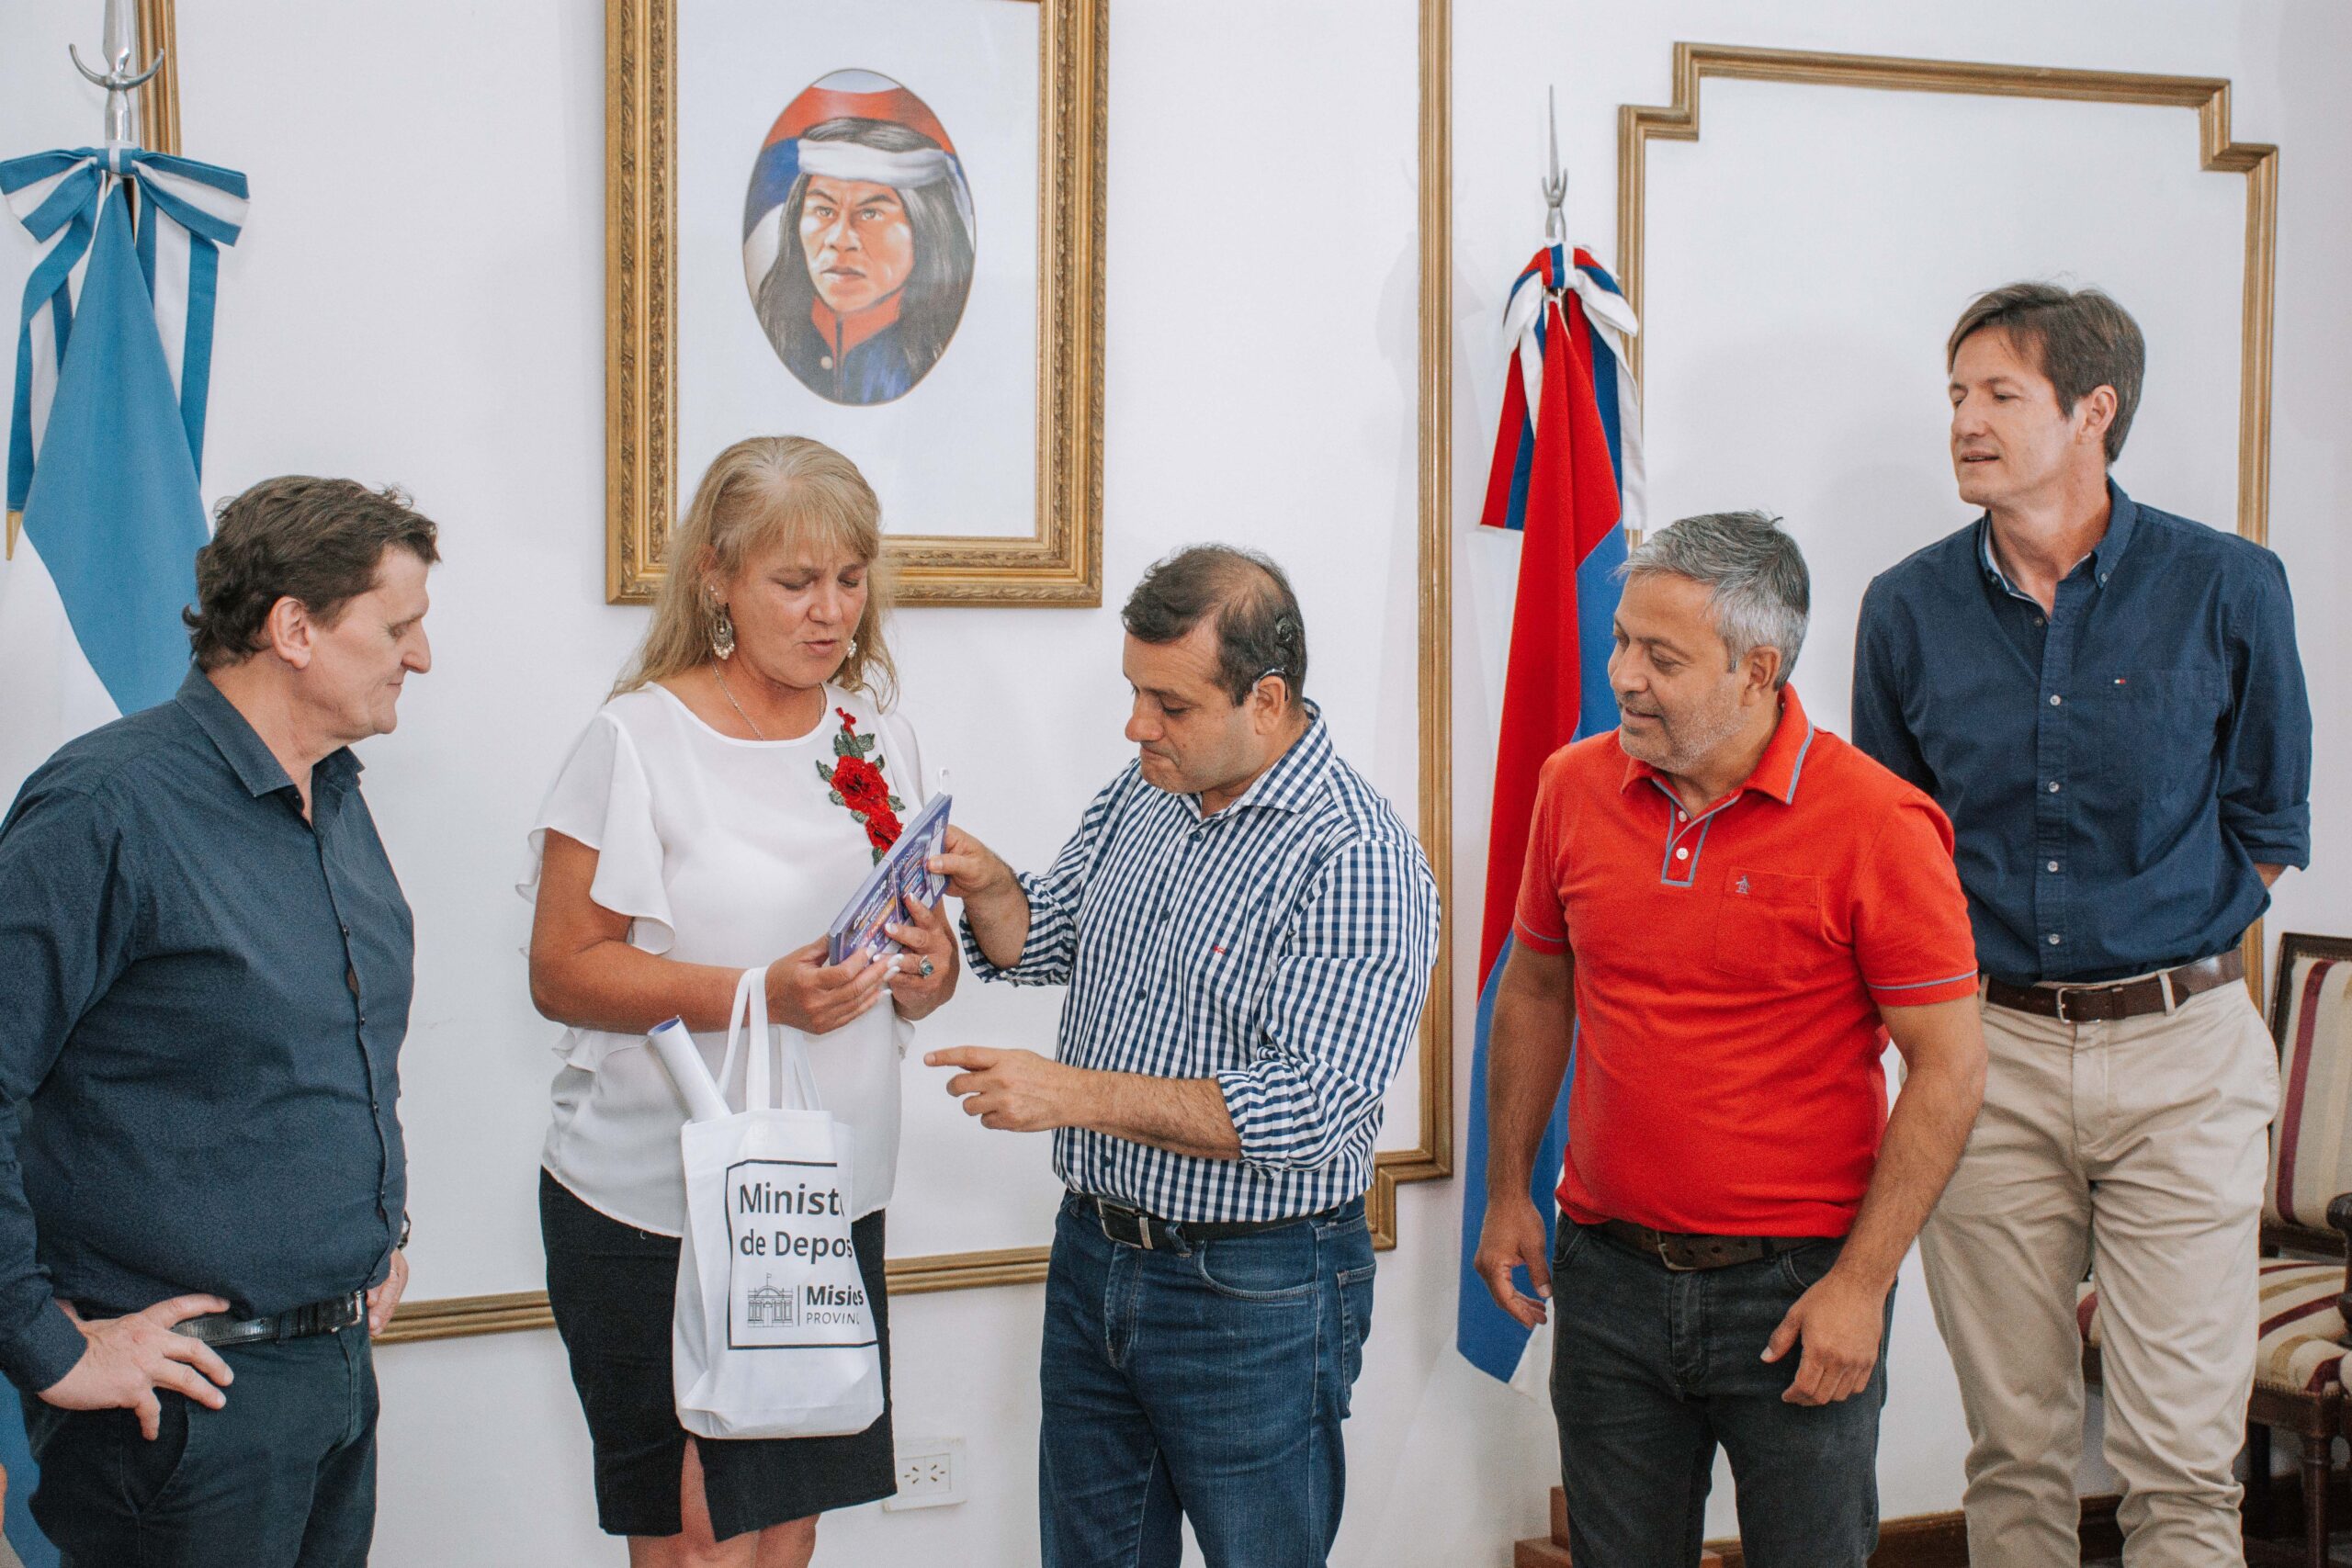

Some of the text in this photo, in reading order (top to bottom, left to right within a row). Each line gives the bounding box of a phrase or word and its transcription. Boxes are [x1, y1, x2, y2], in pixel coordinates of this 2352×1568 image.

[739, 1181, 844, 1216] Minist
[740, 1228, 766, 1257] de
[806, 1312, 860, 1325] PROVIN
